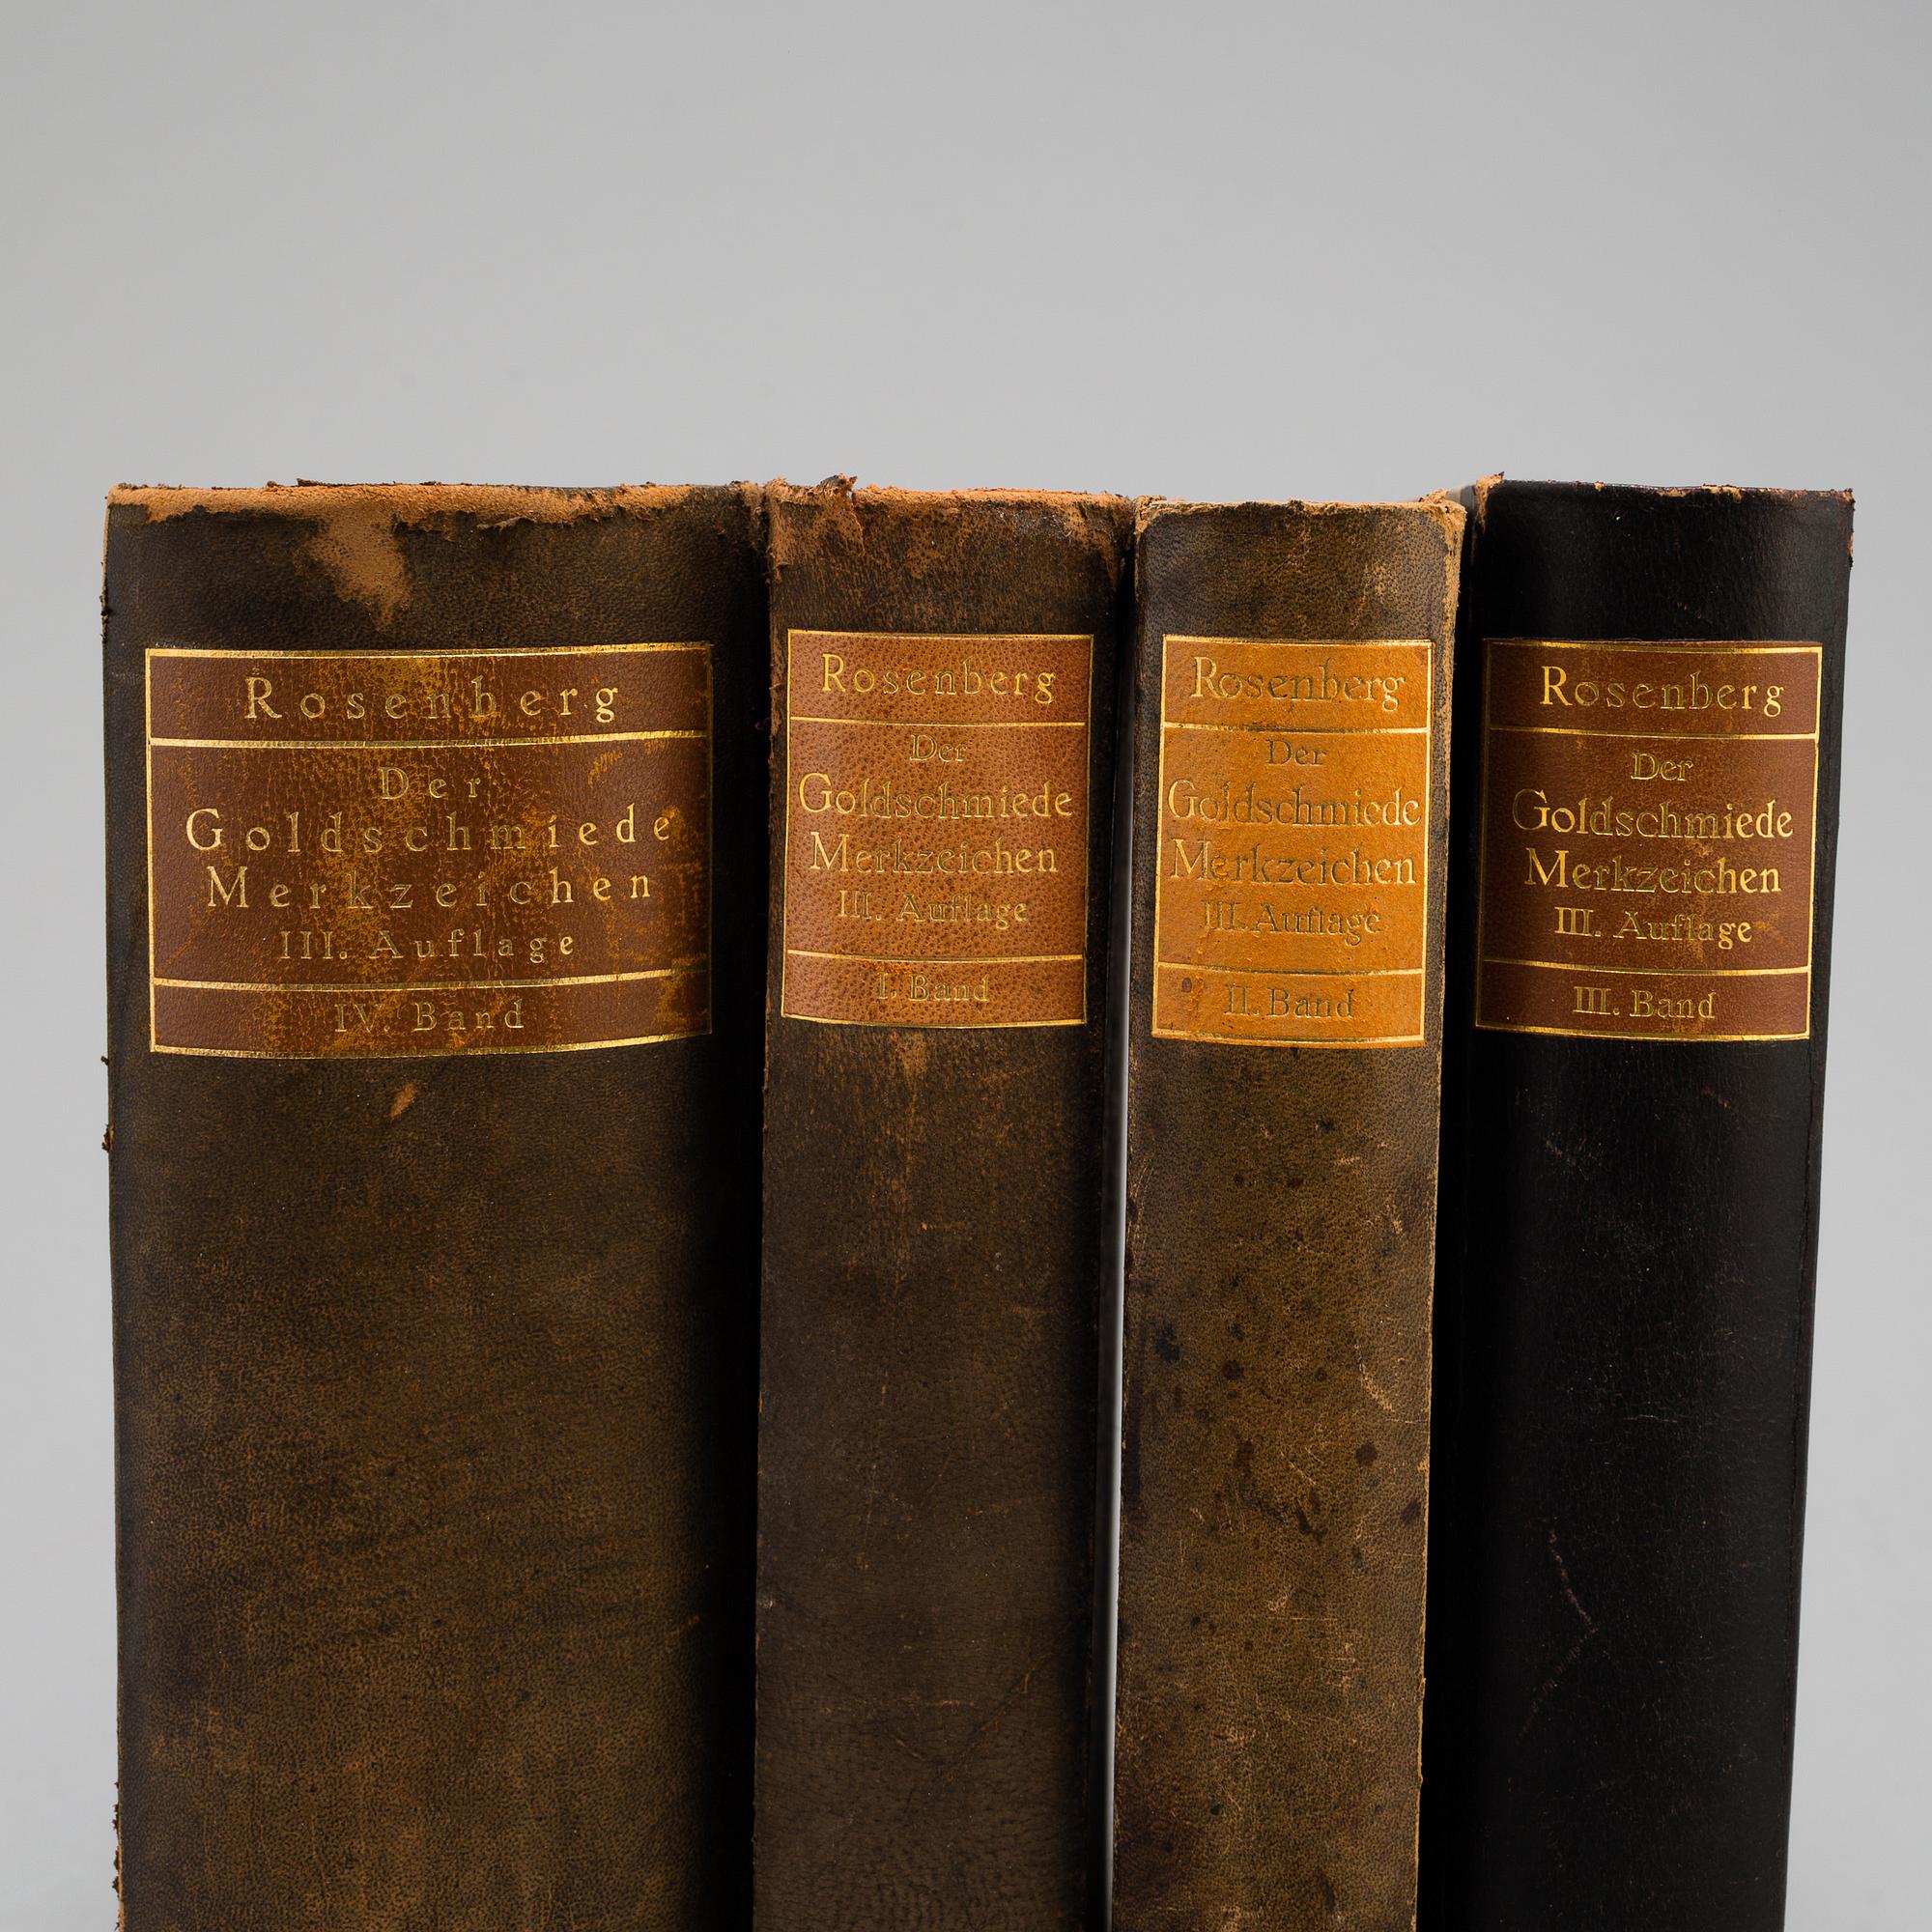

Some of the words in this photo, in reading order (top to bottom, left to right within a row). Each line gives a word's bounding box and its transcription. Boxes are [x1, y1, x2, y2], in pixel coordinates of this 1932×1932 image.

[244, 676, 619, 723] Rosenberg
[821, 653, 1057, 704] Rosenberg
[1190, 656, 1406, 712] Rosenberg
[1540, 666, 1784, 717] Rosenberg
[909, 733, 967, 762] Der
[1266, 739, 1328, 766] Der
[1631, 753, 1693, 781] Der
[380, 766, 482, 799] Der
[798, 773, 1073, 819] Goldschmiede
[1167, 779, 1421, 827] Goldschmiede
[185, 805, 671, 852] Goldschmiede
[1512, 788, 1794, 839] Goldschmiede
[810, 831, 1059, 874] Merkzeichen
[1170, 838, 1416, 886] Merkzeichen
[1524, 847, 1781, 894] Merkzeichen
[207, 866, 652, 910] Merkzeichen
[838, 890, 882, 921] III.
[896, 895, 1029, 929] Auflage
[1203, 900, 1246, 930] III.
[1254, 903, 1380, 946] Auflage
[1553, 907, 1602, 937] III.
[1613, 911, 1753, 950] Auflage
[279, 930, 348, 960] III.
[369, 930, 574, 963] Auflage
[877, 972, 897, 999] I.
[909, 973, 991, 1002] Band
[1224, 983, 1259, 1015] II.
[1267, 987, 1354, 1019] Band
[1573, 986, 1619, 1015] III.
[1629, 989, 1717, 1019] Band
[334, 1003, 389, 1033] IV.
[413, 1001, 525, 1031] Band
